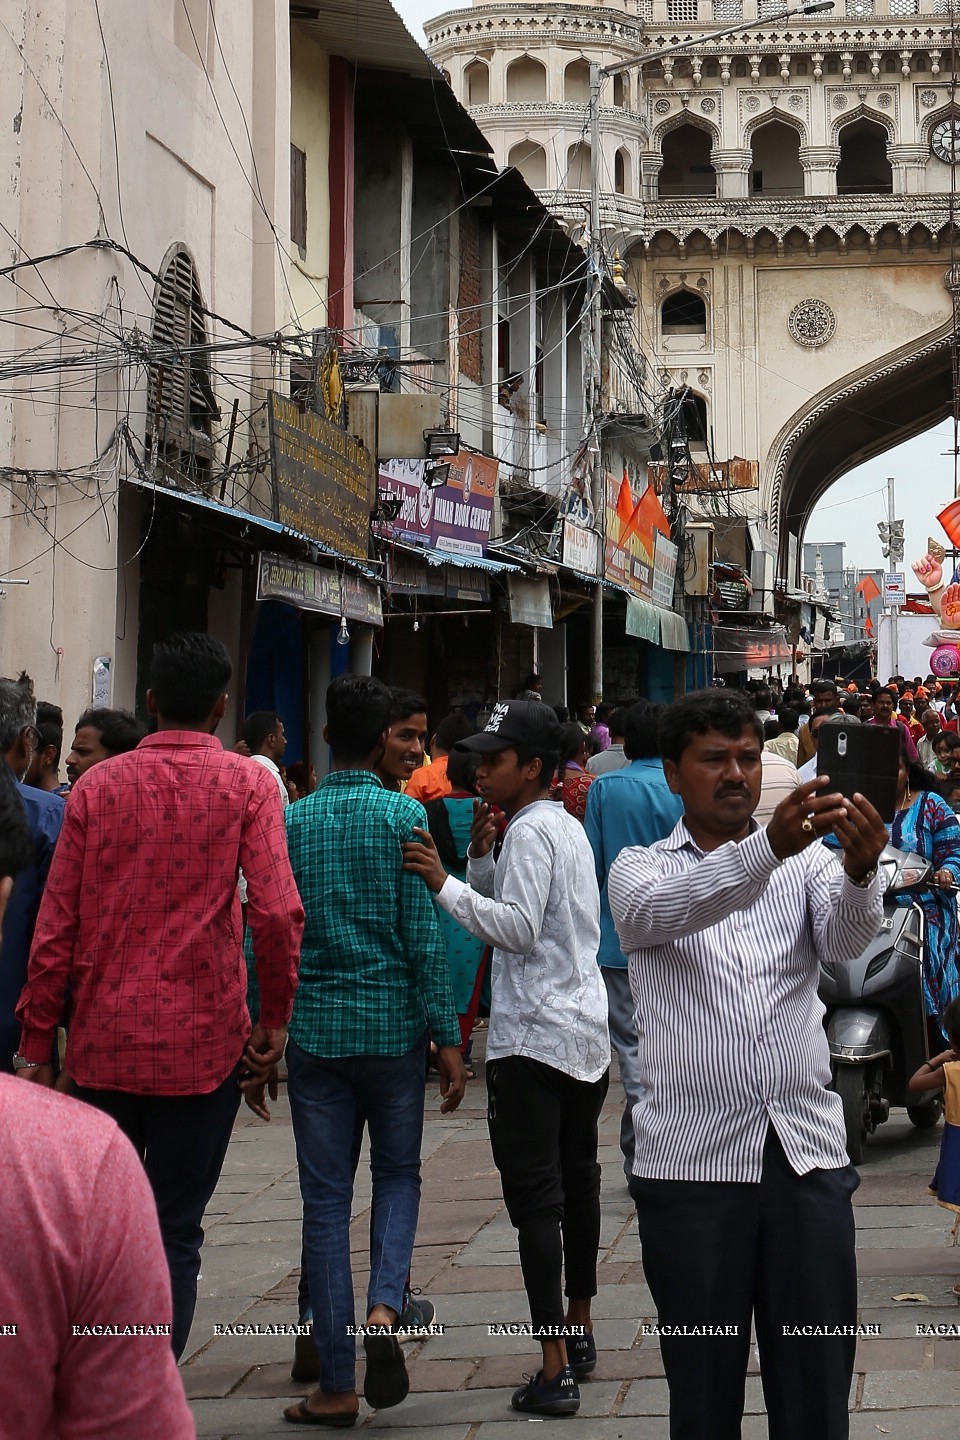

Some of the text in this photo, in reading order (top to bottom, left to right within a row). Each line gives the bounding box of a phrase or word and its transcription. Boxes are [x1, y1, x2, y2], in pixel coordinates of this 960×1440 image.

[454, 503, 471, 528] BOOK
[470, 507, 492, 532] CENTRE
[575, 1341, 588, 1350] AIR
[560, 1378, 575, 1387] AIR
